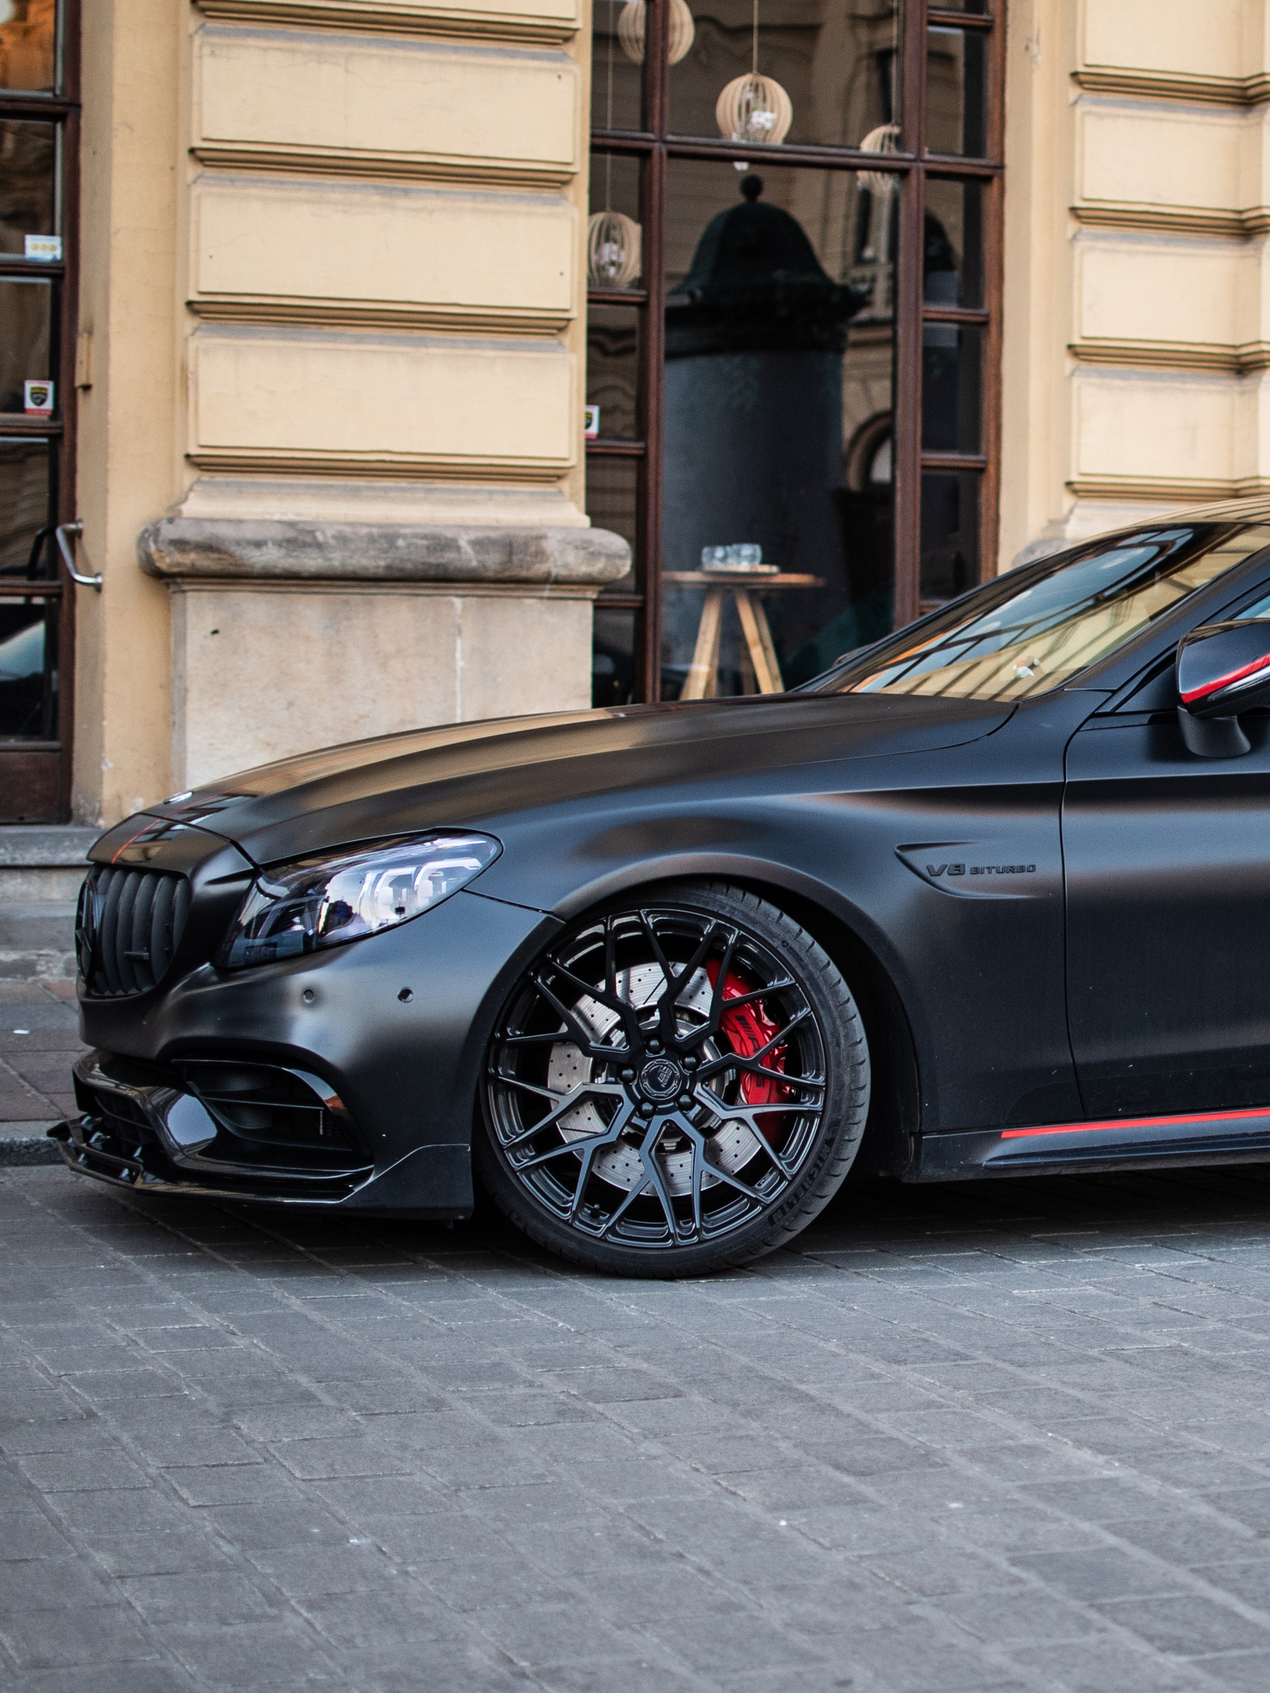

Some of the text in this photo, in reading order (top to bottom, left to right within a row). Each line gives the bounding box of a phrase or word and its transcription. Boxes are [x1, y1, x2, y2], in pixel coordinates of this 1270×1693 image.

[926, 864, 1037, 876] V8 BITURBO
[772, 1142, 832, 1222] MICHELIN
